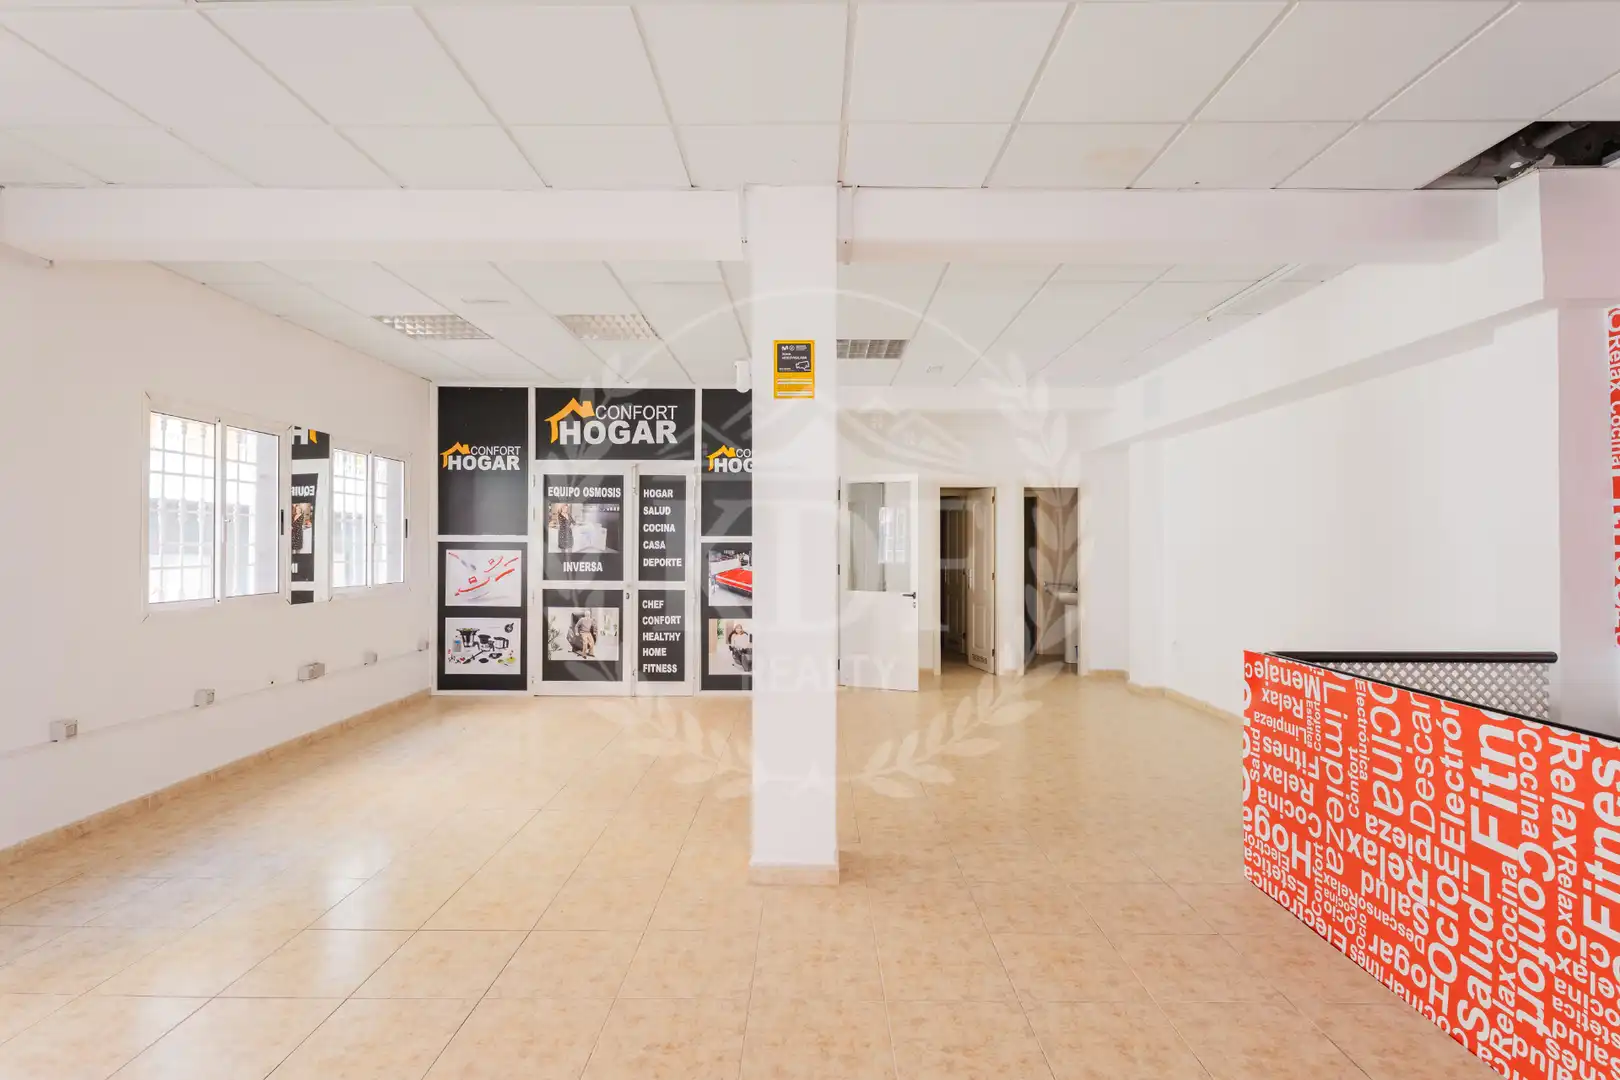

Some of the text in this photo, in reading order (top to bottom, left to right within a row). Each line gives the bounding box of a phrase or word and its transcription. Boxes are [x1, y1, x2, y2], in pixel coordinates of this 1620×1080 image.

[559, 420, 678, 445] HOGAR
[596, 405, 678, 421] CONFORT
[447, 455, 520, 471] HOGAR
[470, 445, 521, 456] CONFORT
[548, 486, 622, 498] EQUIPO OSMOSIS
[643, 488, 674, 498] HOGAR
[643, 506, 671, 515] SALUD
[643, 523, 676, 533] COCINA
[643, 540, 666, 550] CASA
[563, 561, 603, 573] INVERSA
[643, 557, 682, 567] DEPORTE
[642, 600, 664, 609] CHEF
[642, 615, 681, 625] CONFORT
[642, 632, 681, 642] HEALTHY
[642, 647, 667, 657] HOME
[642, 663, 678, 673] FITNESS
[1261, 687, 1304, 720] Relax
[1253, 711, 1308, 745] Limpieza
[1262, 735, 1320, 780] Fitnes
[1262, 761, 1314, 807] Relax
[1320, 681, 1350, 876] Limpieza
[1347, 746, 1360, 819] Confort
[1517, 728, 1545, 839] Cocina
[1548, 736, 1586, 859] Relax
[1258, 785, 1322, 839] Cocina
[1345, 827, 1429, 907] Relax
[1364, 811, 1491, 904] Limpieza
[1312, 841, 1323, 918] Confort
[1323, 872, 1358, 909] Relax
[1556, 854, 1578, 926] Relax
[1323, 900, 1356, 935] Ocio
[1360, 869, 1429, 936] Salud
[1496, 860, 1519, 964] Cocina
[1355, 913, 1367, 951] Ocio
[1358, 897, 1425, 954] Descanso
[1427, 874, 1460, 984] Ocio
[1516, 841, 1556, 1041] Confort
[1367, 933, 1450, 1015] Hogar
[1456, 892, 1495, 1043] Salud
[1556, 951, 1620, 1001] elax
[1488, 963, 1517, 1061] Relax
[1554, 975, 1620, 1027] ocina
